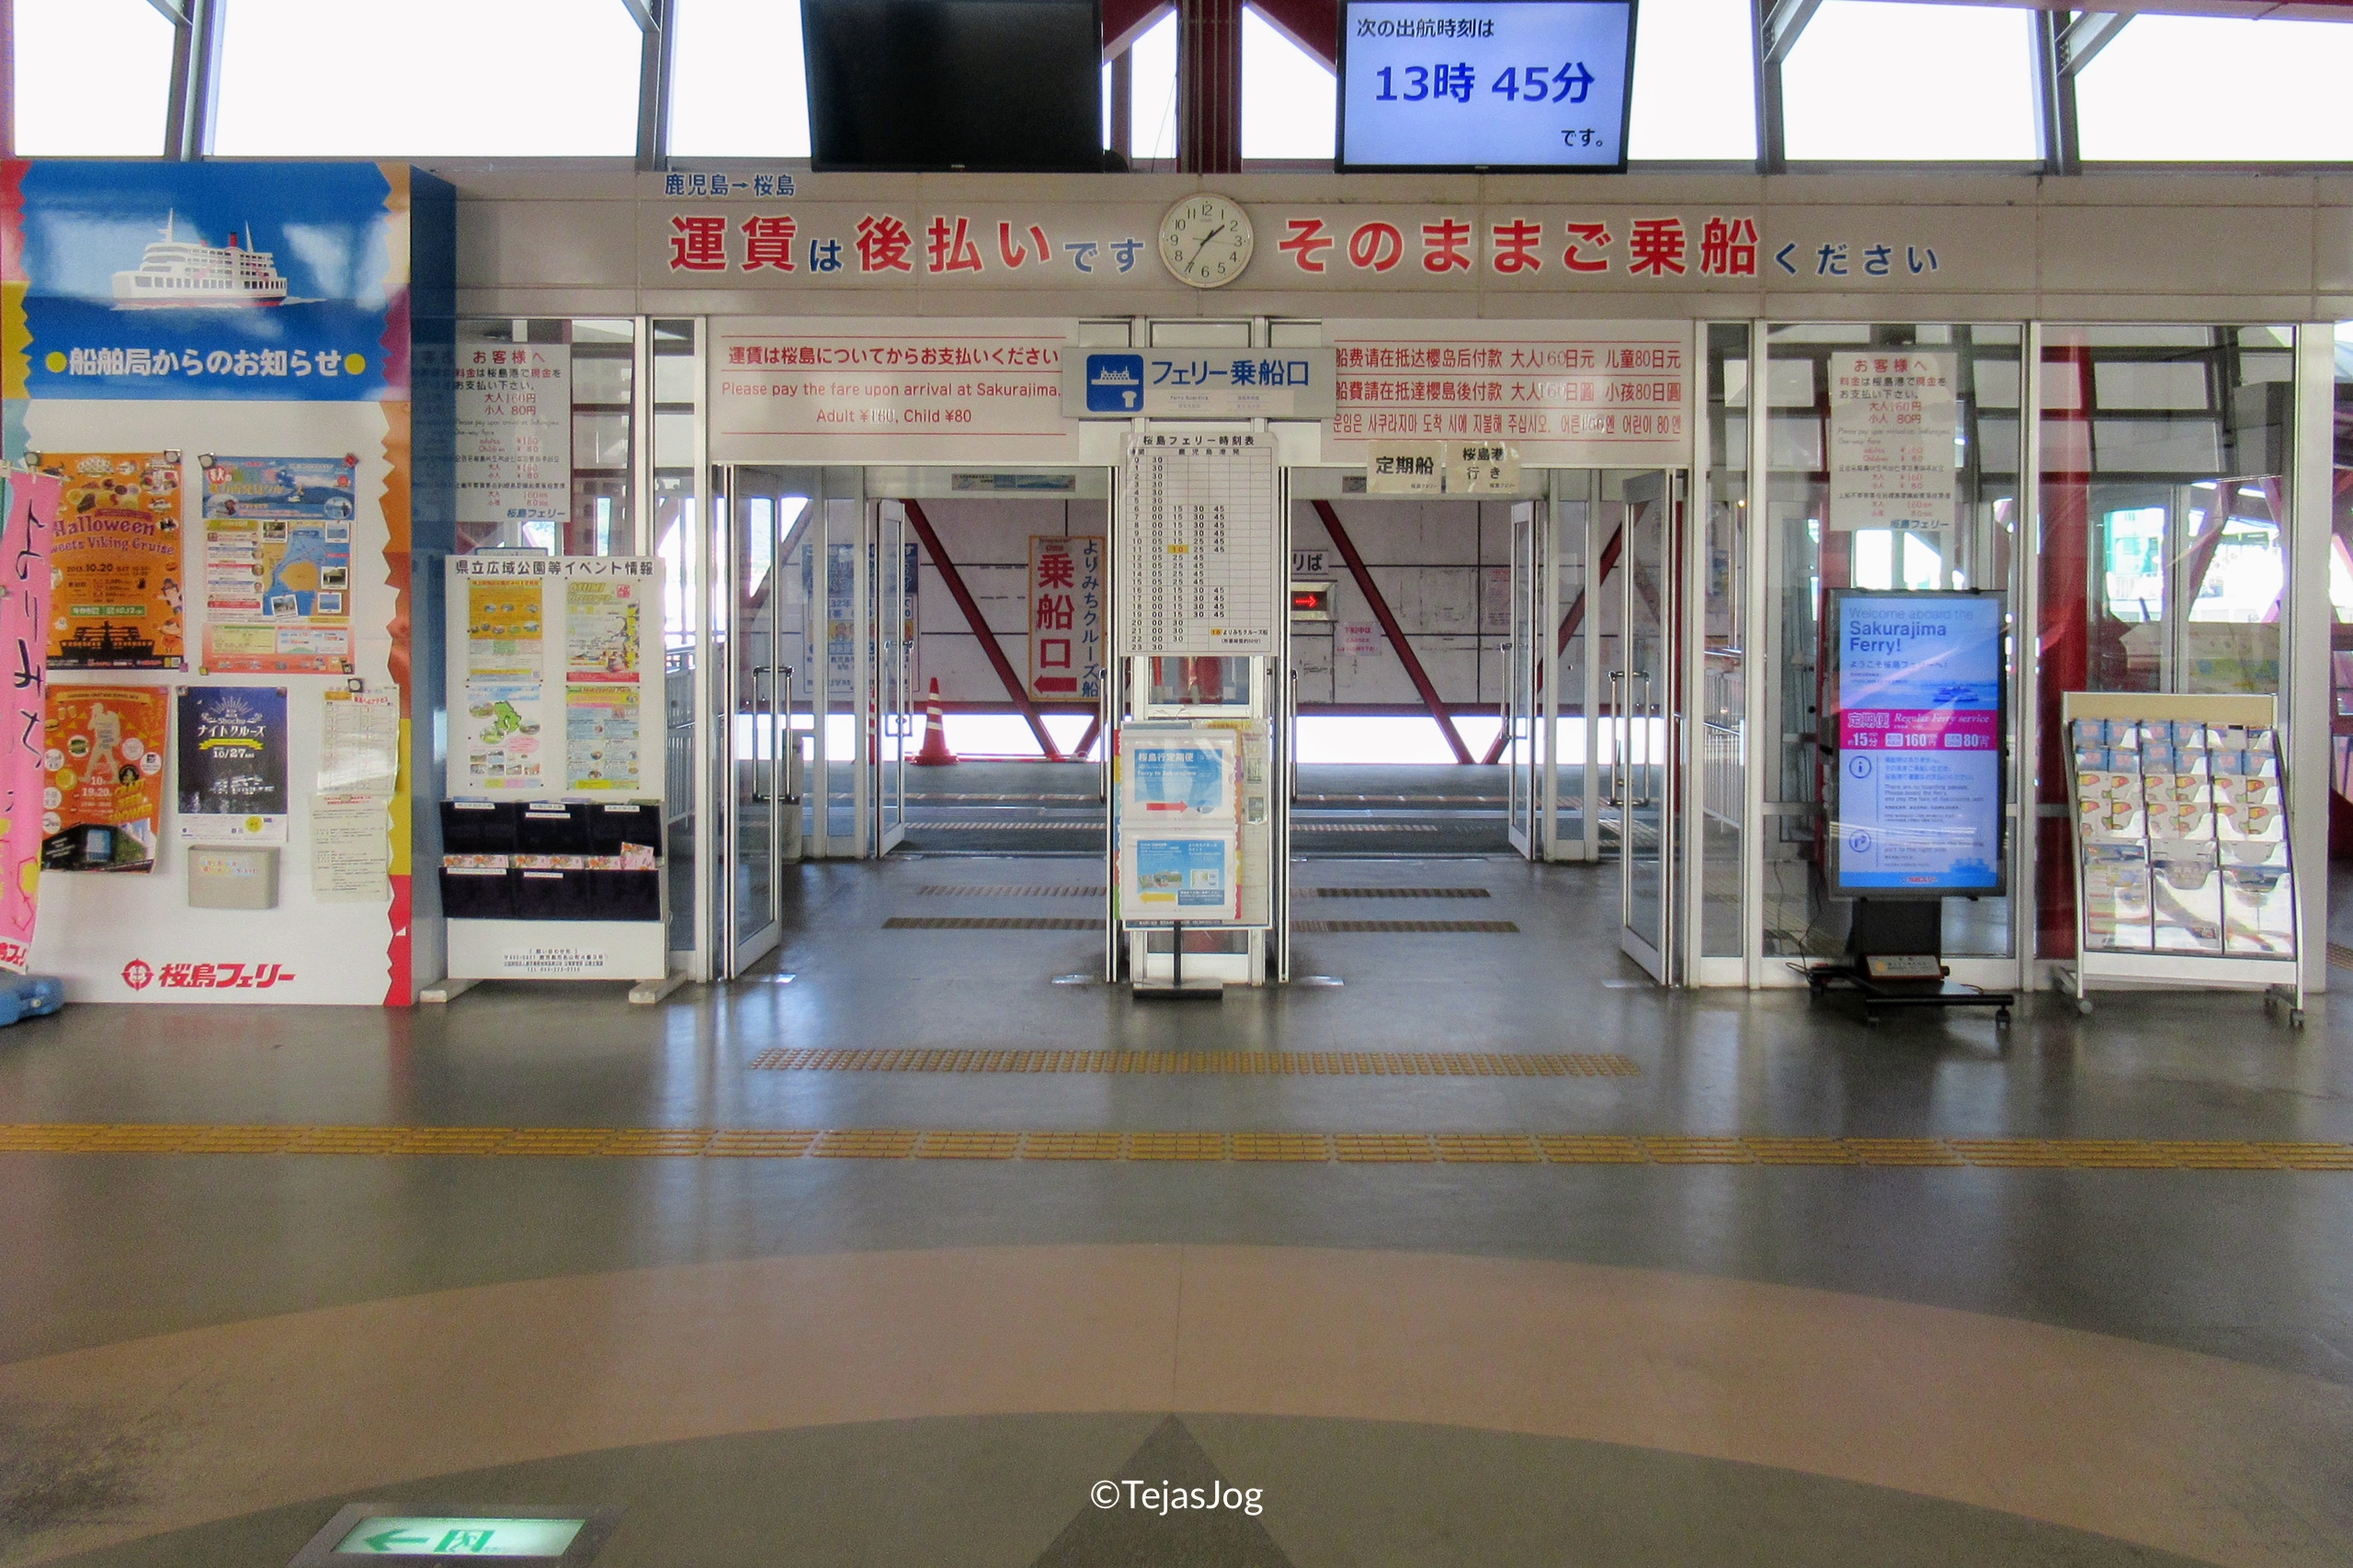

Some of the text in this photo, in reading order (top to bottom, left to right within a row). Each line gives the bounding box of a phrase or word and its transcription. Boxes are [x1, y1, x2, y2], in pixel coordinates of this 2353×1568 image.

[1357, 18, 1495, 38] 次の出航時刻は
[1376, 62, 1595, 104] 13時 45分
[1561, 128, 1604, 148] です。
[664, 173, 796, 197] 鹿児島 桜島
[1188, 209, 1196, 220] 11
[1202, 204, 1212, 216] 12
[1176, 219, 1186, 231] 10
[1230, 221, 1238, 232] 2
[669, 214, 1145, 274] 運賃は後払いです
[1170, 234, 1178, 246] 9
[1234, 236, 1243, 247] 3
[1279, 216, 1939, 277] そのままご乗船ください
[1175, 250, 1183, 262] 8
[1229, 251, 1237, 262] 4
[1201, 266, 1210, 278] 6
[1218, 262, 1225, 274] 5
[69, 347, 341, 376] 船舶局からのお知らせ
[473, 350, 546, 365] お客様へ
[728, 346, 1059, 366] 運賃は桜島についてからお支払いください
[1511, 348, 1595, 369] 大人160日元
[1605, 348, 1681, 369] 儿童80日元
[1152, 359, 1309, 386] フェリー乗船口
[1854, 358, 1927, 373] お客様へ
[1839, 377, 1947, 387] 料金は桜島港で現金を
[722, 382, 1061, 398] Please pay the fare upon arrival at Sakurajima.
[1511, 381, 1595, 402] 大人160日圓
[1605, 381, 1681, 402] 小孩80日圓
[1839, 390, 1919, 400] お支払い下さい。
[484, 405, 536, 415] 小人 80円
[816, 409, 855, 424] Adult
[904, 409, 940, 424] Child
[945, 409, 972, 424] ¥80
[1333, 414, 1362, 433] 운임은
[1368, 414, 1417, 433] 사쿠라지마
[1423, 414, 1442, 433] 도착
[1449, 414, 1467, 433] 시에
[1473, 414, 1502, 433] 지불해
[1508, 415, 1551, 434] 주십시오.
[1623, 415, 1652, 434] 어린이
[1657, 416, 1669, 434] 80
[1672, 415, 1681, 434] 엔
[1869, 414, 1922, 425] 小人 80円
[1143, 435, 1255, 446] 桜島フェリー時刻表
[1463, 447, 1506, 460] 桜島港
[1376, 457, 1435, 475] 定期船
[1467, 467, 1501, 481] 行き
[507, 508, 566, 518] 桜島フェリー
[54, 515, 155, 537] Halloween
[1890, 519, 1949, 529] 桜島フェリー
[86, 537, 129, 552] Viking
[132, 538, 175, 555] Cruise
[456, 560, 654, 575] 県立広域公園等イベント情報
[1037, 553, 1075, 669] 乗船口
[1849, 608, 1905, 619] Welcome
[1082, 540, 1099, 698] よりみちクルーズ船
[1849, 621, 1947, 639] Sakurajima
[1849, 638, 1901, 655] Ferry!
[1894, 713, 1990, 725] Regular Ferry service
[198, 724, 267, 737] ナイトクルーズ
[213, 748, 245, 758] 10/27
[158, 963, 297, 989] 桜島フェリー
